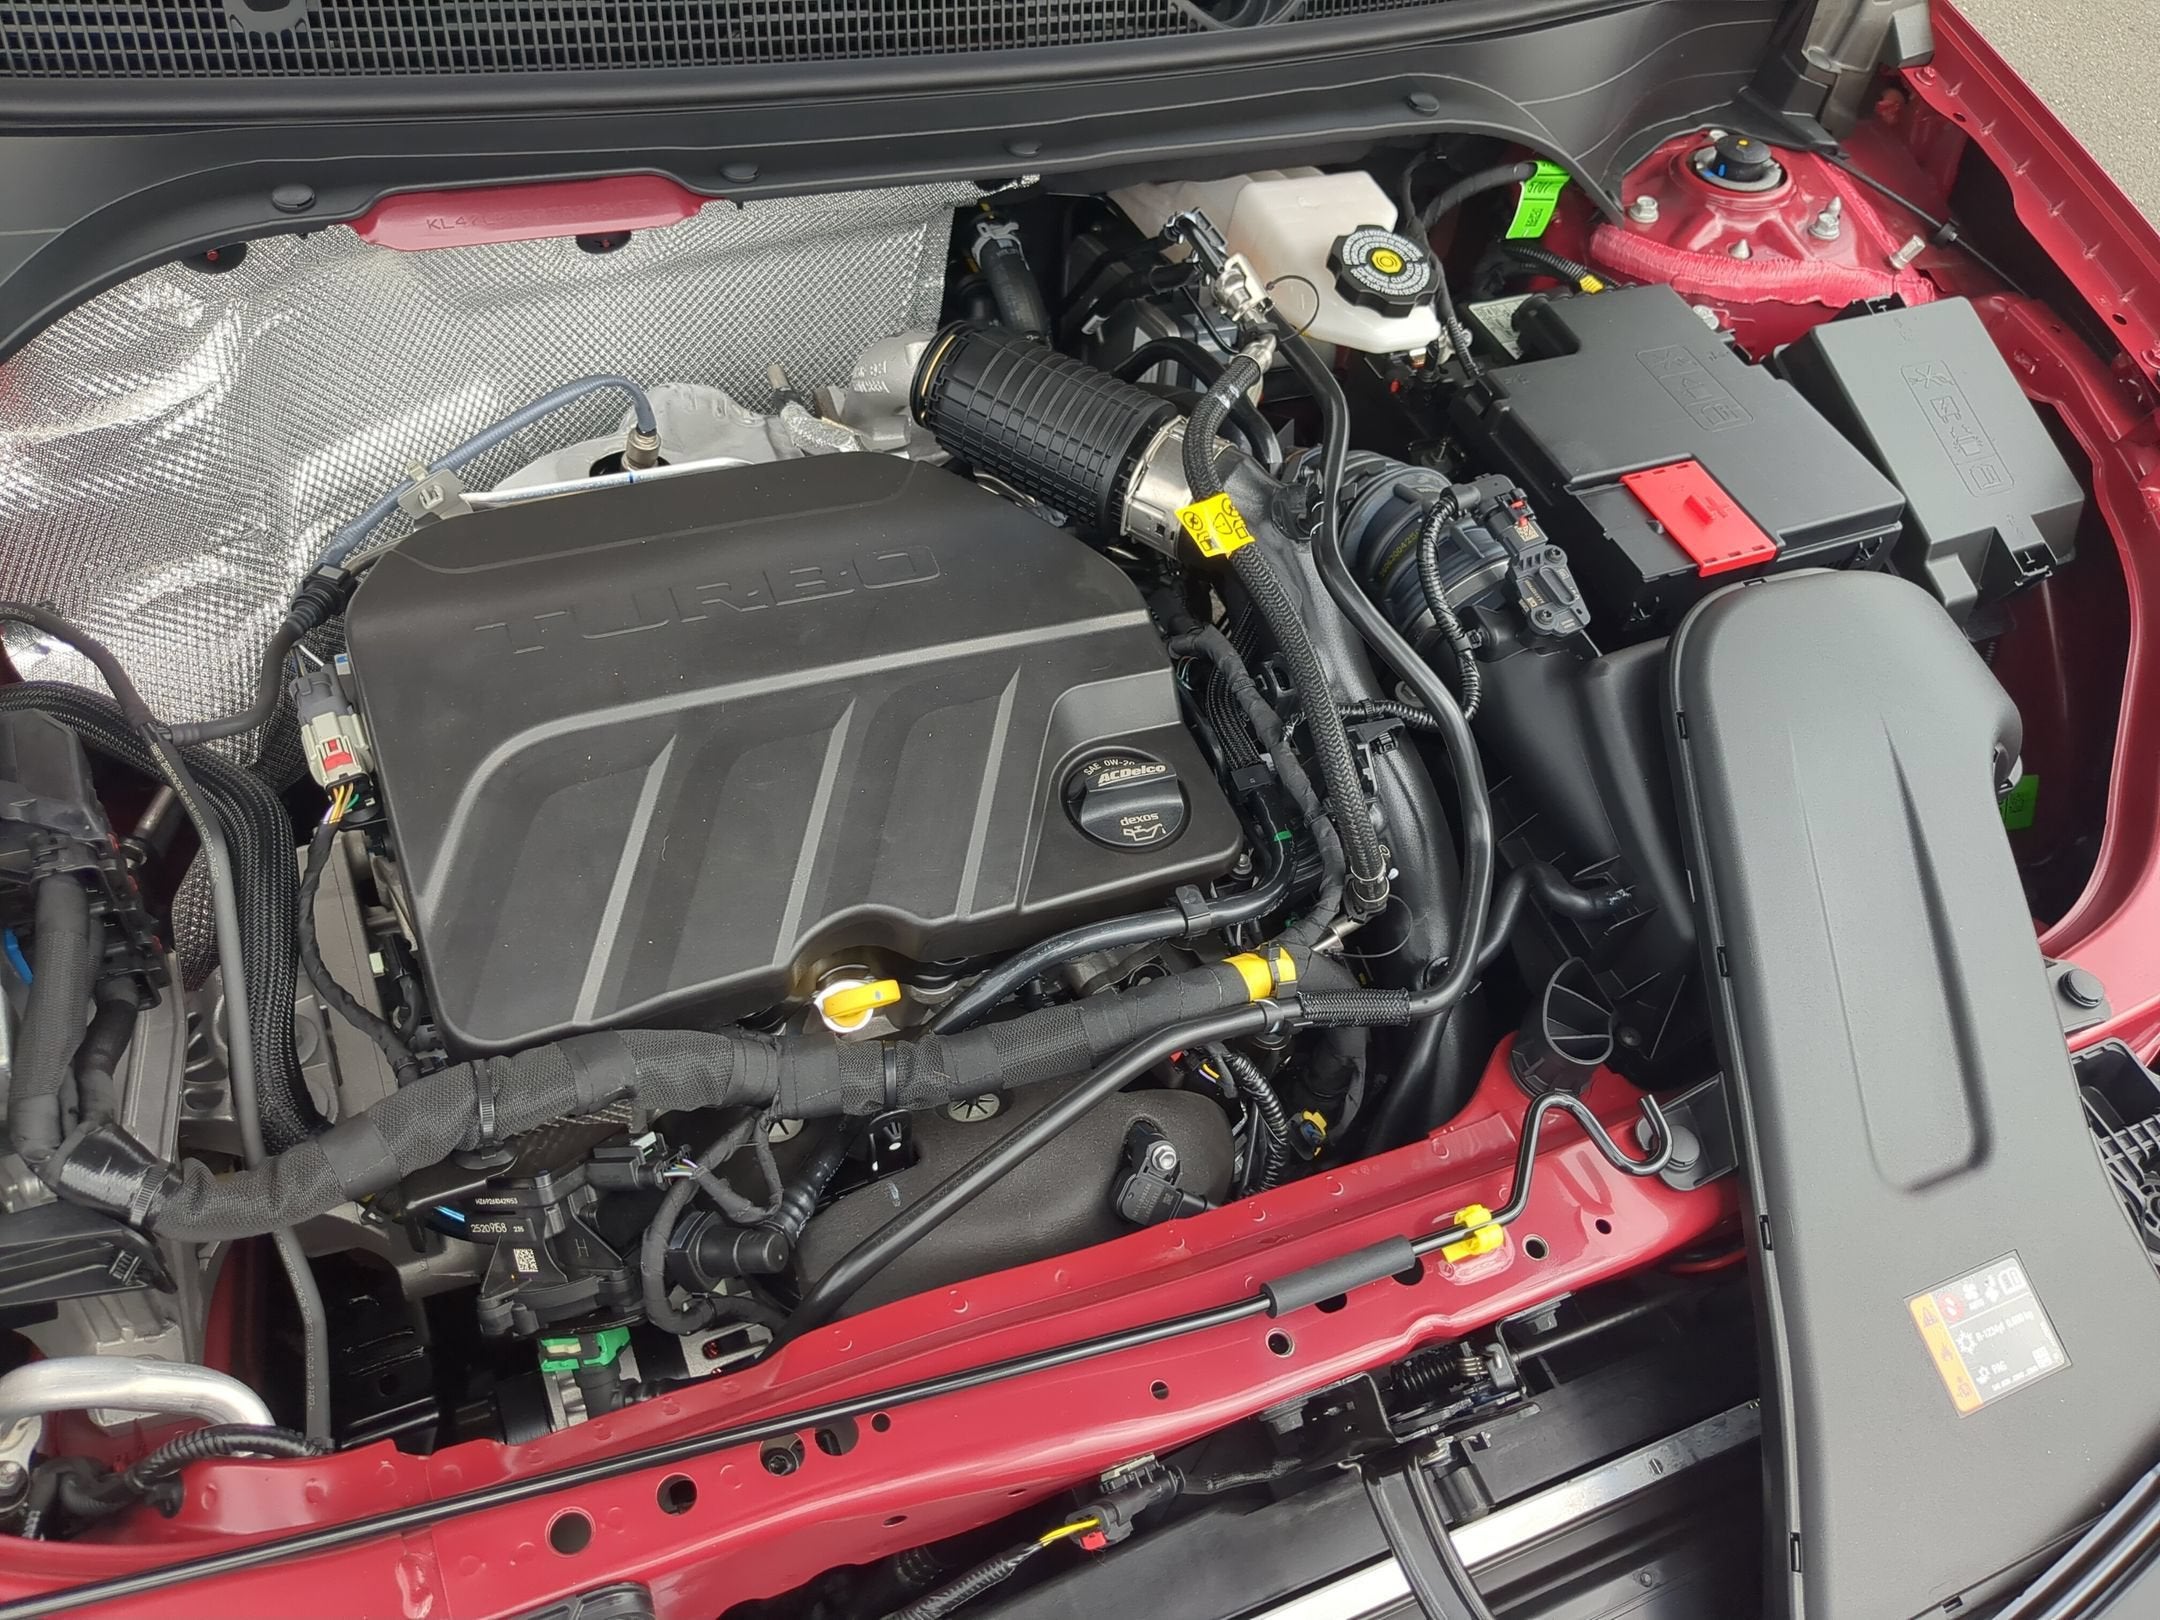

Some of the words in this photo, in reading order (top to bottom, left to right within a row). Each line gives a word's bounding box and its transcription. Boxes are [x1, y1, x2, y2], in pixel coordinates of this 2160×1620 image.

[474, 545, 941, 654] TURBO
[1083, 762, 1102, 776] SAE
[1097, 764, 1166, 785] ACDelco
[1120, 812, 1159, 826] dexos
